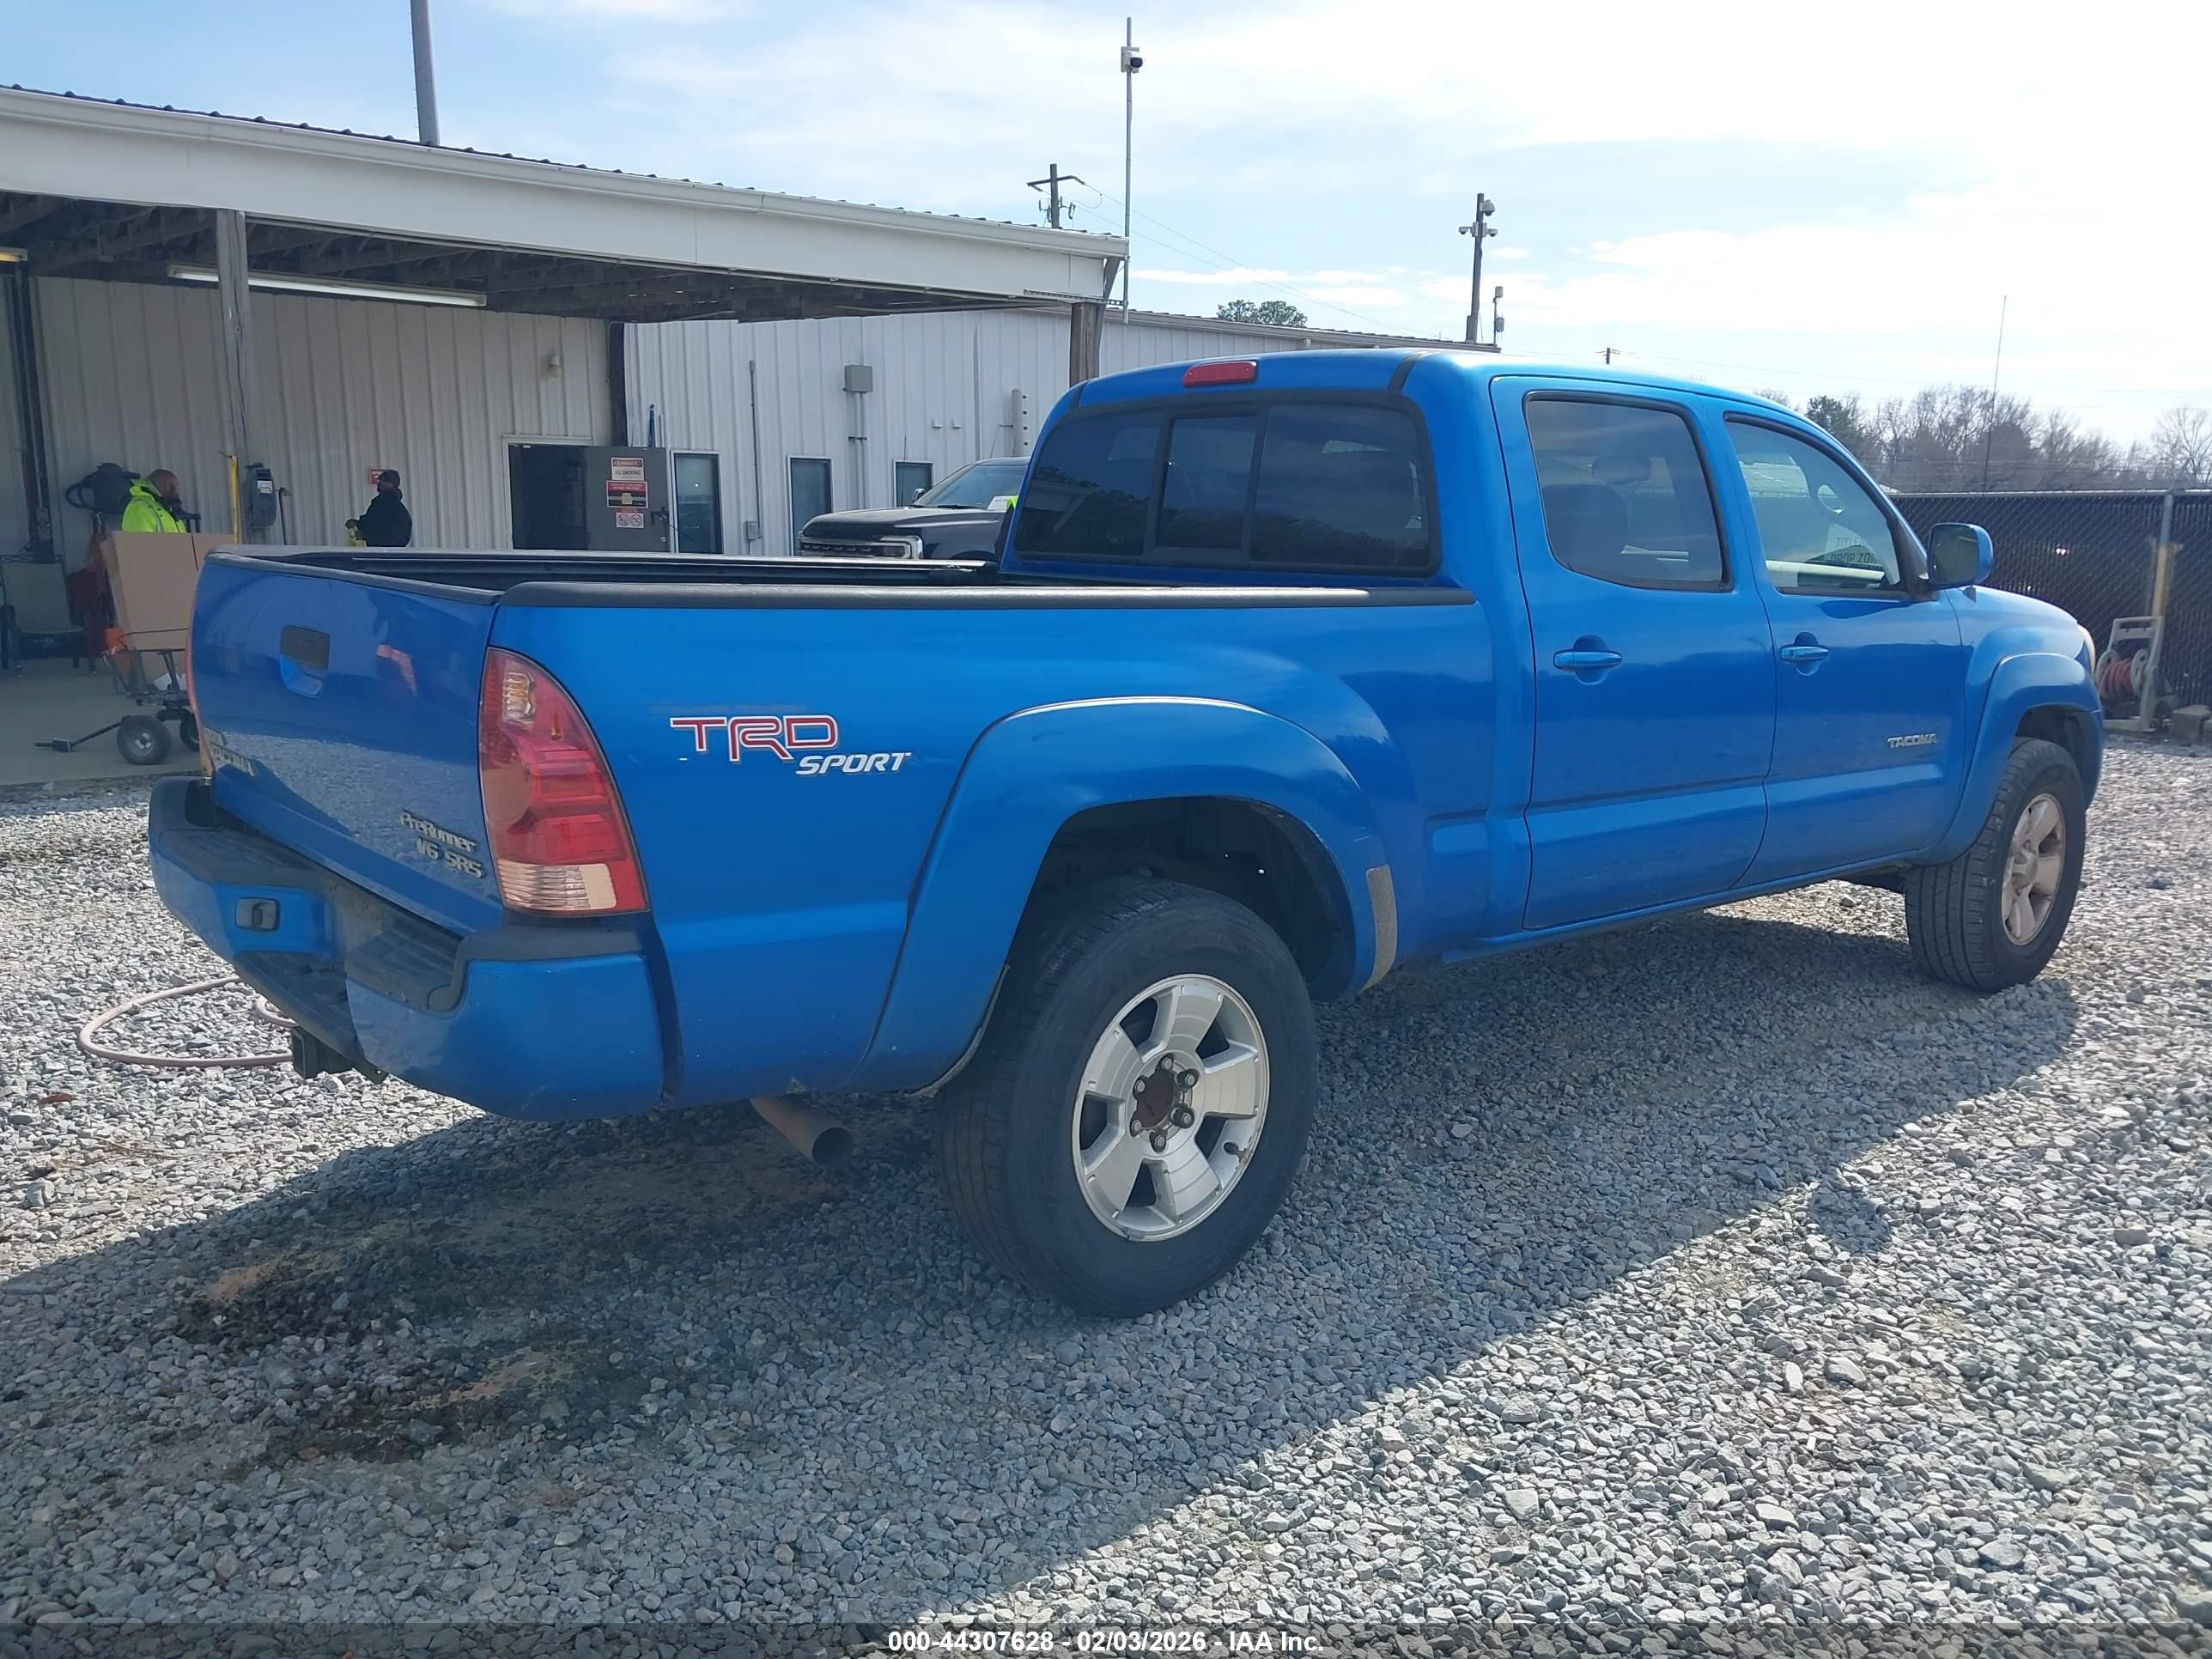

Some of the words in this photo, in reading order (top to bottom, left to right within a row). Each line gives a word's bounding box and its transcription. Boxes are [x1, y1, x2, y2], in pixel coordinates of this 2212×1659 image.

[670, 715, 837, 762] TRD
[1887, 733, 1937, 748] TACOMA
[795, 752, 912, 775] SPORT
[399, 811, 477, 852] PreRunner
[417, 837, 439, 860] V6
[445, 851, 483, 878] SR5
